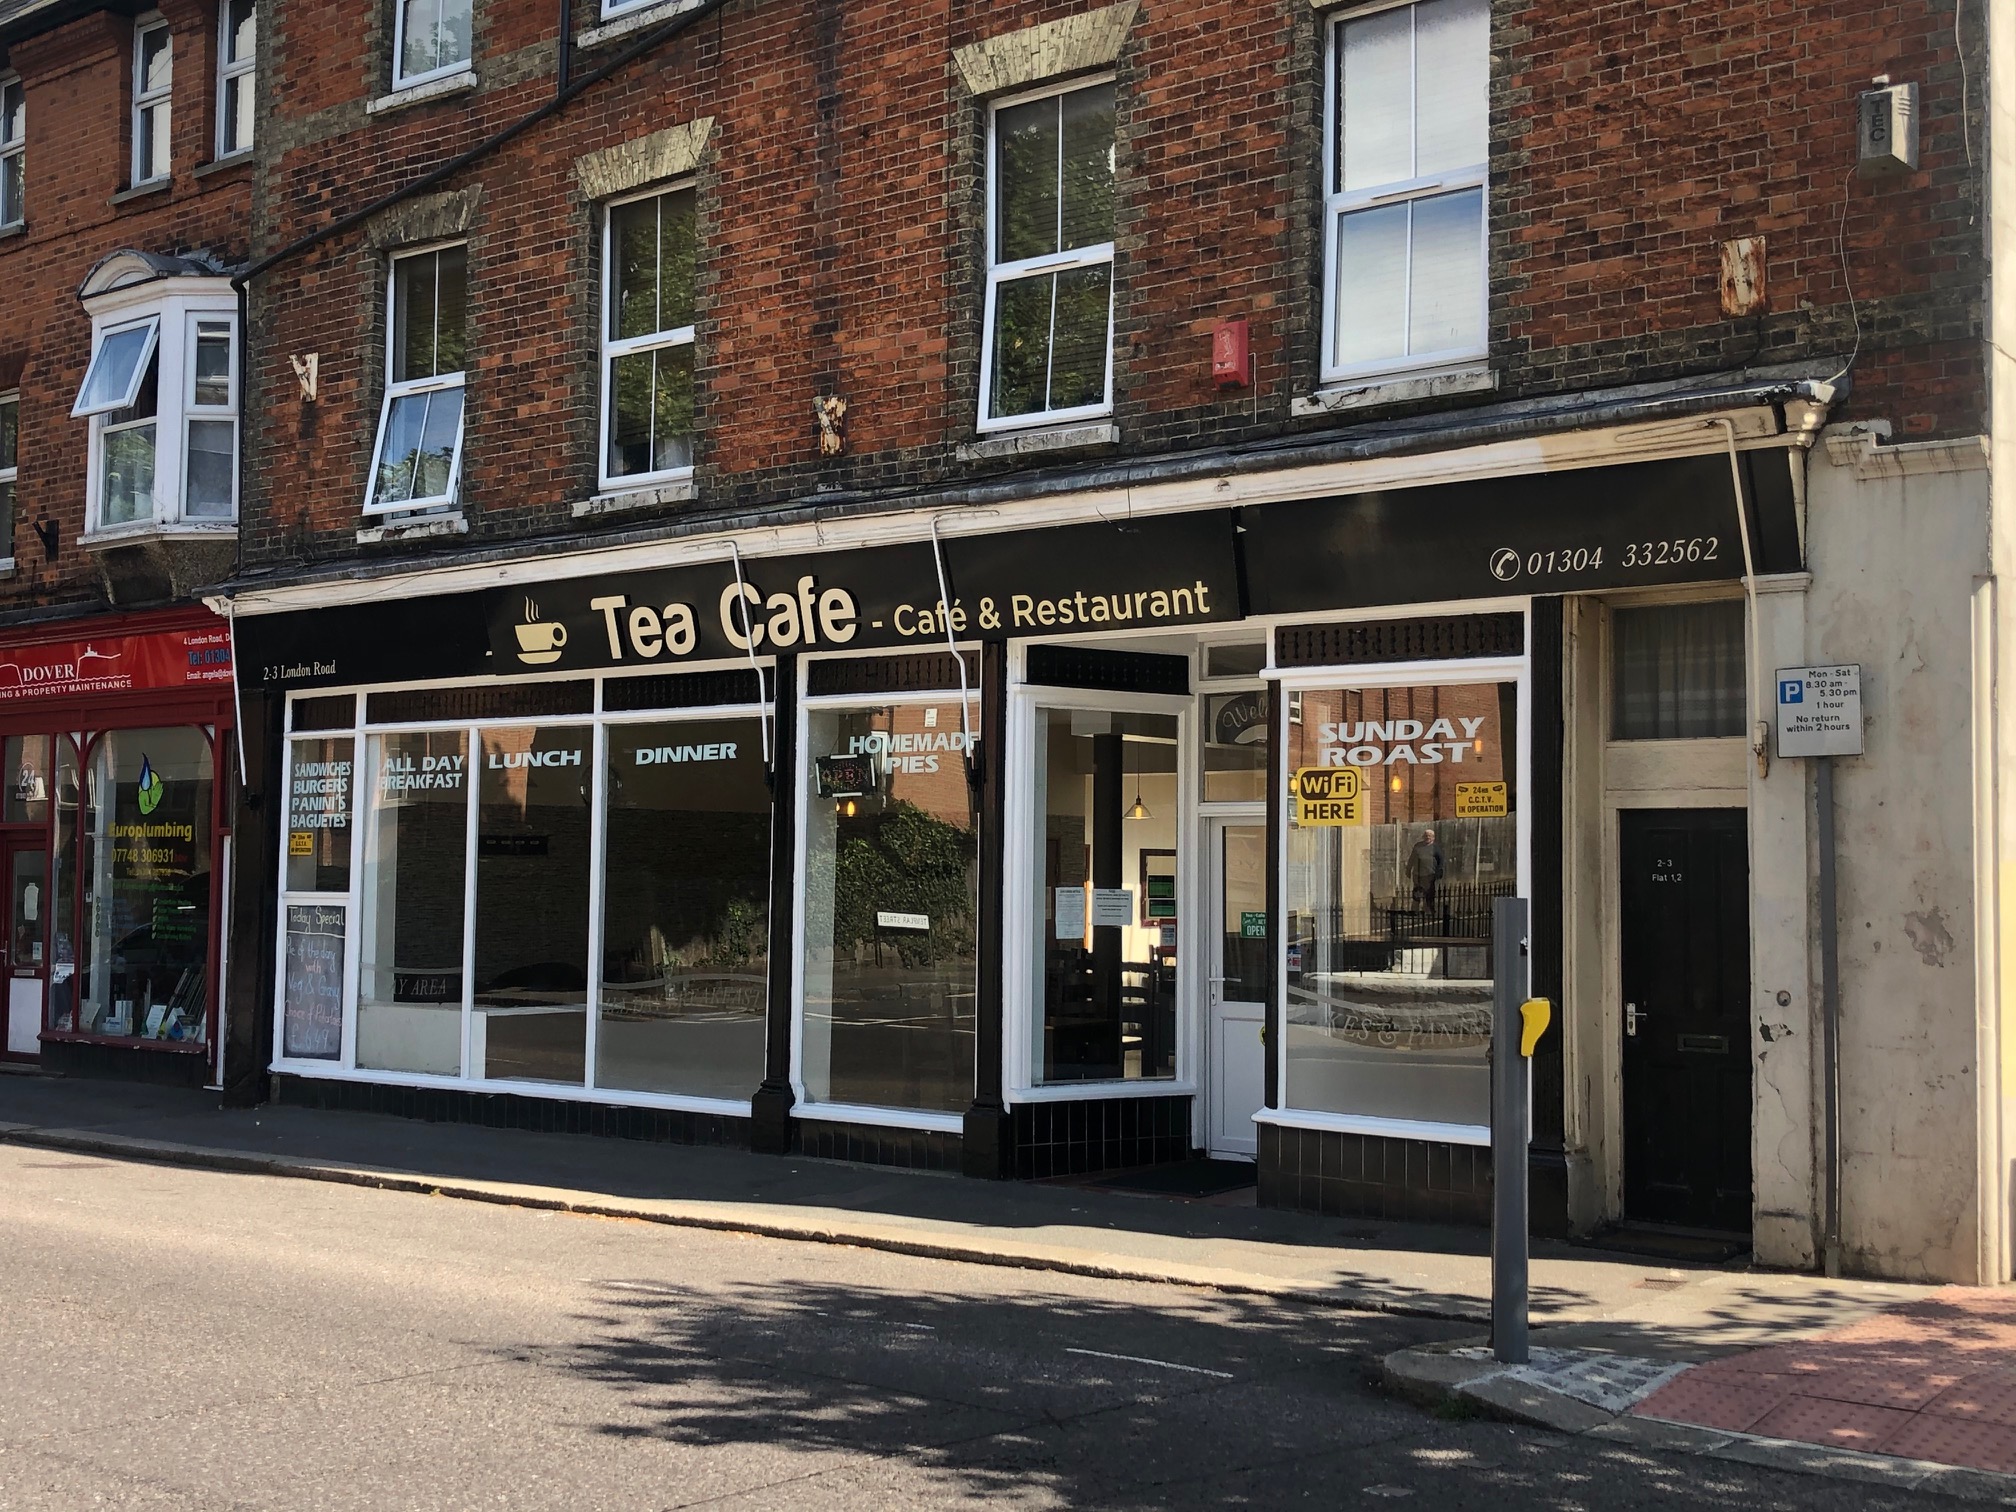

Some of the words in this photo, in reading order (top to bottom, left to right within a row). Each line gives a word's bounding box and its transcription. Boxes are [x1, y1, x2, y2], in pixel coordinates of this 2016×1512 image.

[1527, 547, 1604, 575] 01304
[1622, 537, 1719, 568] 332562
[591, 595, 698, 660] Tea
[719, 575, 859, 651] Cafe
[894, 599, 967, 637] Café
[979, 597, 1001, 630] &
[1011, 580, 1211, 627] Restaurant
[183, 637, 188, 645] 4
[188, 636, 207, 645] London
[188, 651, 203, 665] Tel:
[205, 648, 230, 664] 01304
[23, 664, 76, 682] DOVER
[263, 666, 278, 680] 2-3
[280, 662, 311, 679] London
[313, 659, 337, 676] Road
[1808, 670, 1828, 678] Mon
[1835, 669, 1851, 677] Sat
[15, 690, 21, 698] &
[22, 685, 67, 697] PROPERTY
[68, 680, 132, 693] MAINTENANCE
[1785, 683, 1800, 702] P
[1806, 681, 1827, 689] 8.30
[1820, 689, 1841, 697] 5.30
[1843, 689, 1857, 697] pm
[1223, 698, 1268, 728] Wel
[1816, 701, 1820, 709] 1
[1823, 701, 1844, 709] hour
[1318, 716, 1485, 744] SUNDAY
[1786, 724, 1813, 732] within
[1816, 723, 1822, 731] 2
[1824, 723, 1851, 731] hours
[488, 750, 582, 770] LUNCH
[635, 742, 738, 766] DINNER
[1321, 742, 1473, 767] ROAST
[294, 761, 351, 777] SANDWICHES
[385, 757, 416, 772] ALL
[422, 755, 465, 772] DAY
[886, 754, 939, 775] PIES
[293, 778, 348, 794] BURGERS
[380, 773, 463, 790] BREAKFAST
[291, 795, 346, 811] PANINI'S
[1304, 803, 1354, 819] HERE
[1467, 805, 1504, 813] OPERATION
[291, 813, 346, 828] BAGUETES
[141, 848, 174, 862] 306931
[1657, 859, 1673, 867] 2-3
[1652, 873, 1668, 881] Flat
[315, 905, 345, 932] Special
[1246, 925, 1266, 936] OPEN
[410, 978, 447, 996] AREA
